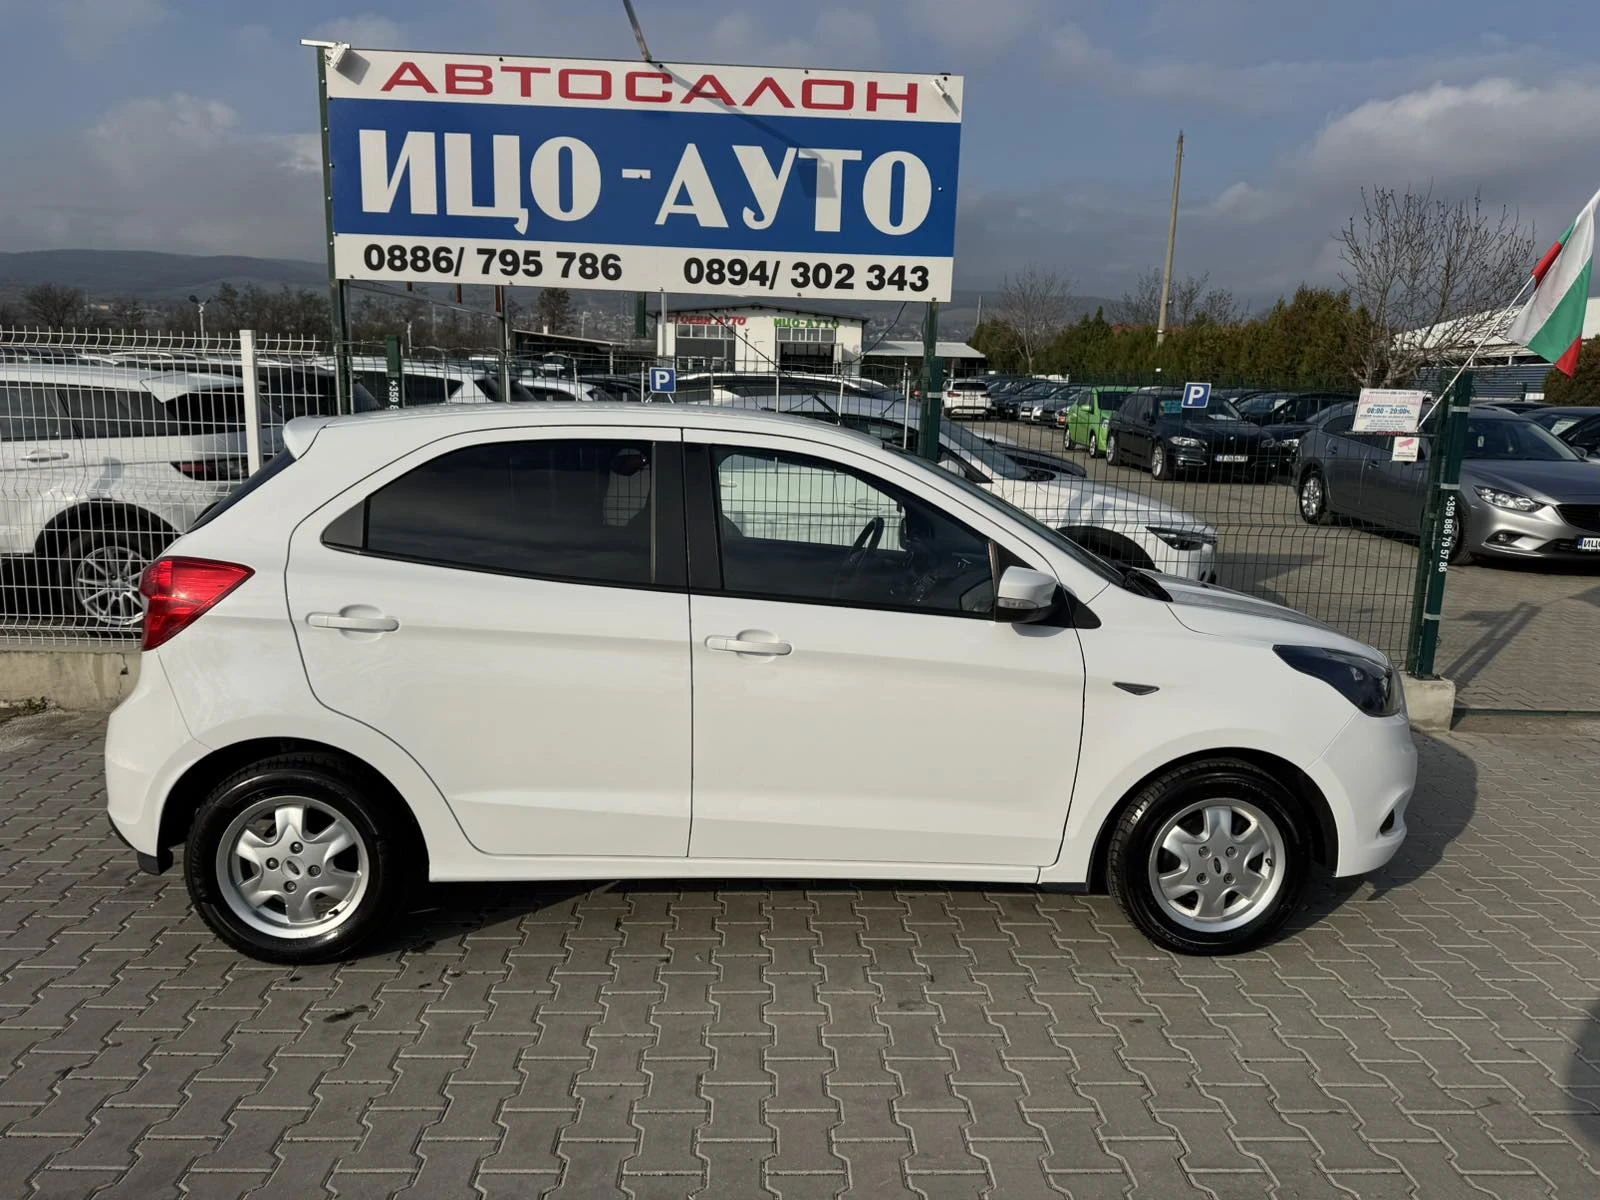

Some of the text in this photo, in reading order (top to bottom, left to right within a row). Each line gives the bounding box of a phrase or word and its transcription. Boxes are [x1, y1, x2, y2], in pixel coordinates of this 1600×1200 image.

[381, 62, 918, 114] АВТОСАЛОН
[358, 129, 602, 235] ИЦО
[363, 243, 929, 293] 0886/ 795 786 0894/ 302 343
[774, 318, 840, 328] ИЦО-АУТО
[389, 380, 399, 403] +359
[655, 370, 670, 390] P
[1187, 386, 1205, 405] P
[1438, 495, 1456, 573] +359 886 79 57 86
